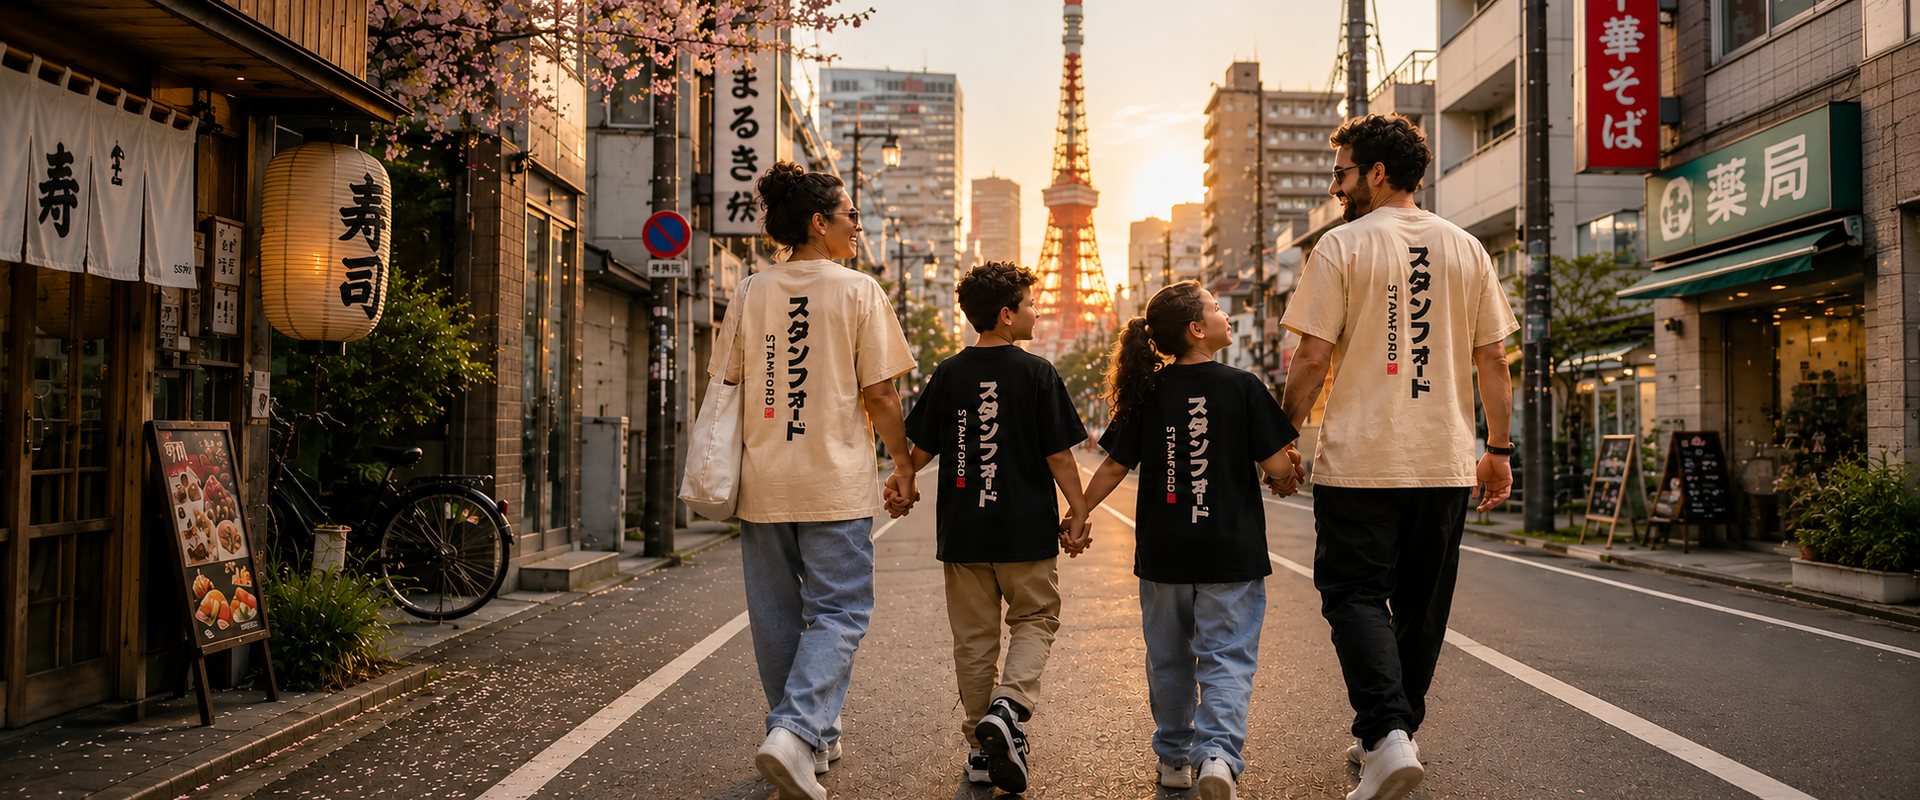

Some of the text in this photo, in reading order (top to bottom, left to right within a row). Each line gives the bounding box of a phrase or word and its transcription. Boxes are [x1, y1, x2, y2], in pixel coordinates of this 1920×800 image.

[38, 141, 80, 239] 寿
[1706, 133, 1809, 227] 薬局
[338, 172, 386, 321] 寿司
[765, 334, 776, 406] STAMFORD
[786, 296, 810, 441] スタンフォード
[1387, 284, 1398, 362] STAMFORD
[1408, 246, 1432, 399] スタンフォード
[977, 381, 999, 508] スタンフォード
[1187, 396, 1210, 524] スタンフォード
